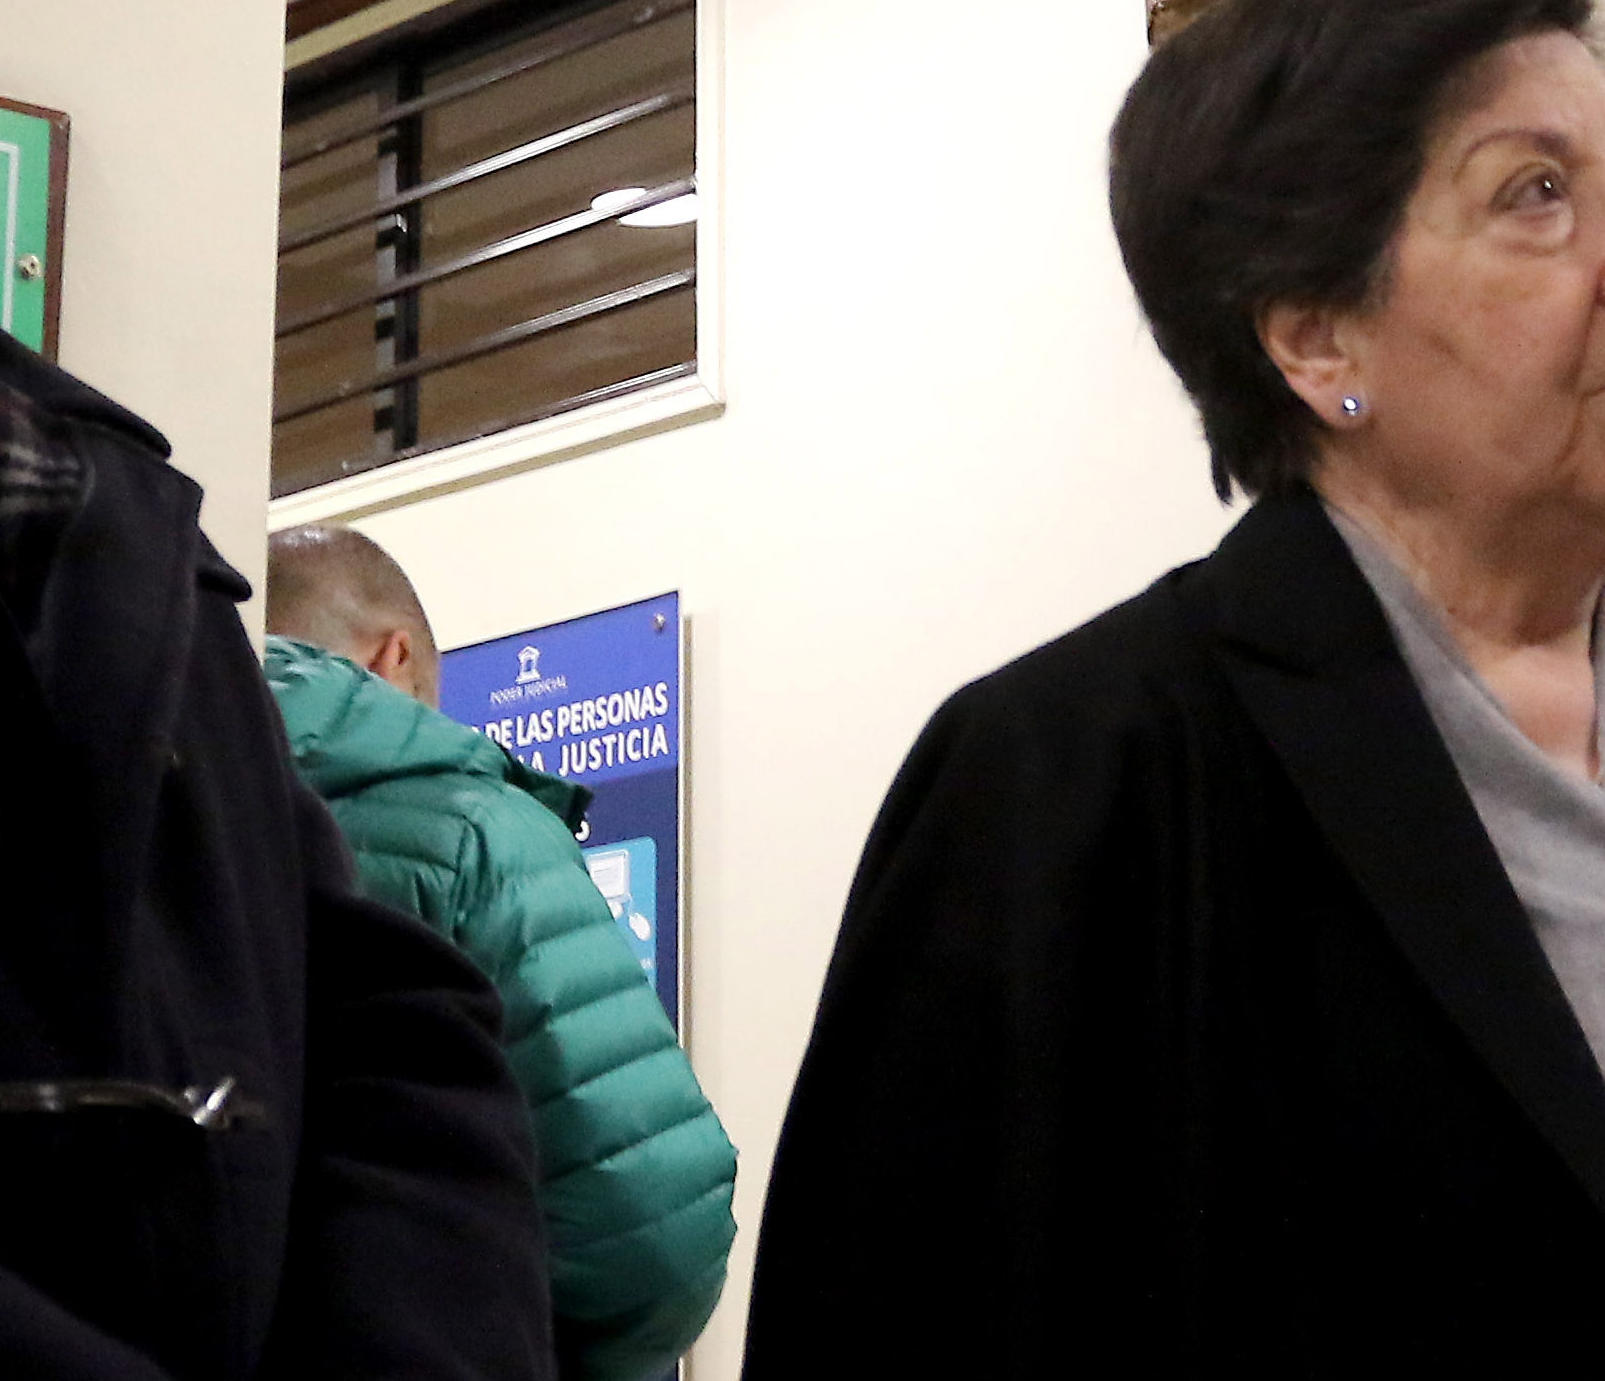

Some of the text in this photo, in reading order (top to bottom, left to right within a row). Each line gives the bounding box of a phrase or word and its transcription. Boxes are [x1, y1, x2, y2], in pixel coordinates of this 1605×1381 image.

[484, 682, 669, 750] DE LAS PERSONAS
[517, 723, 670, 778] A JUSTICIA
